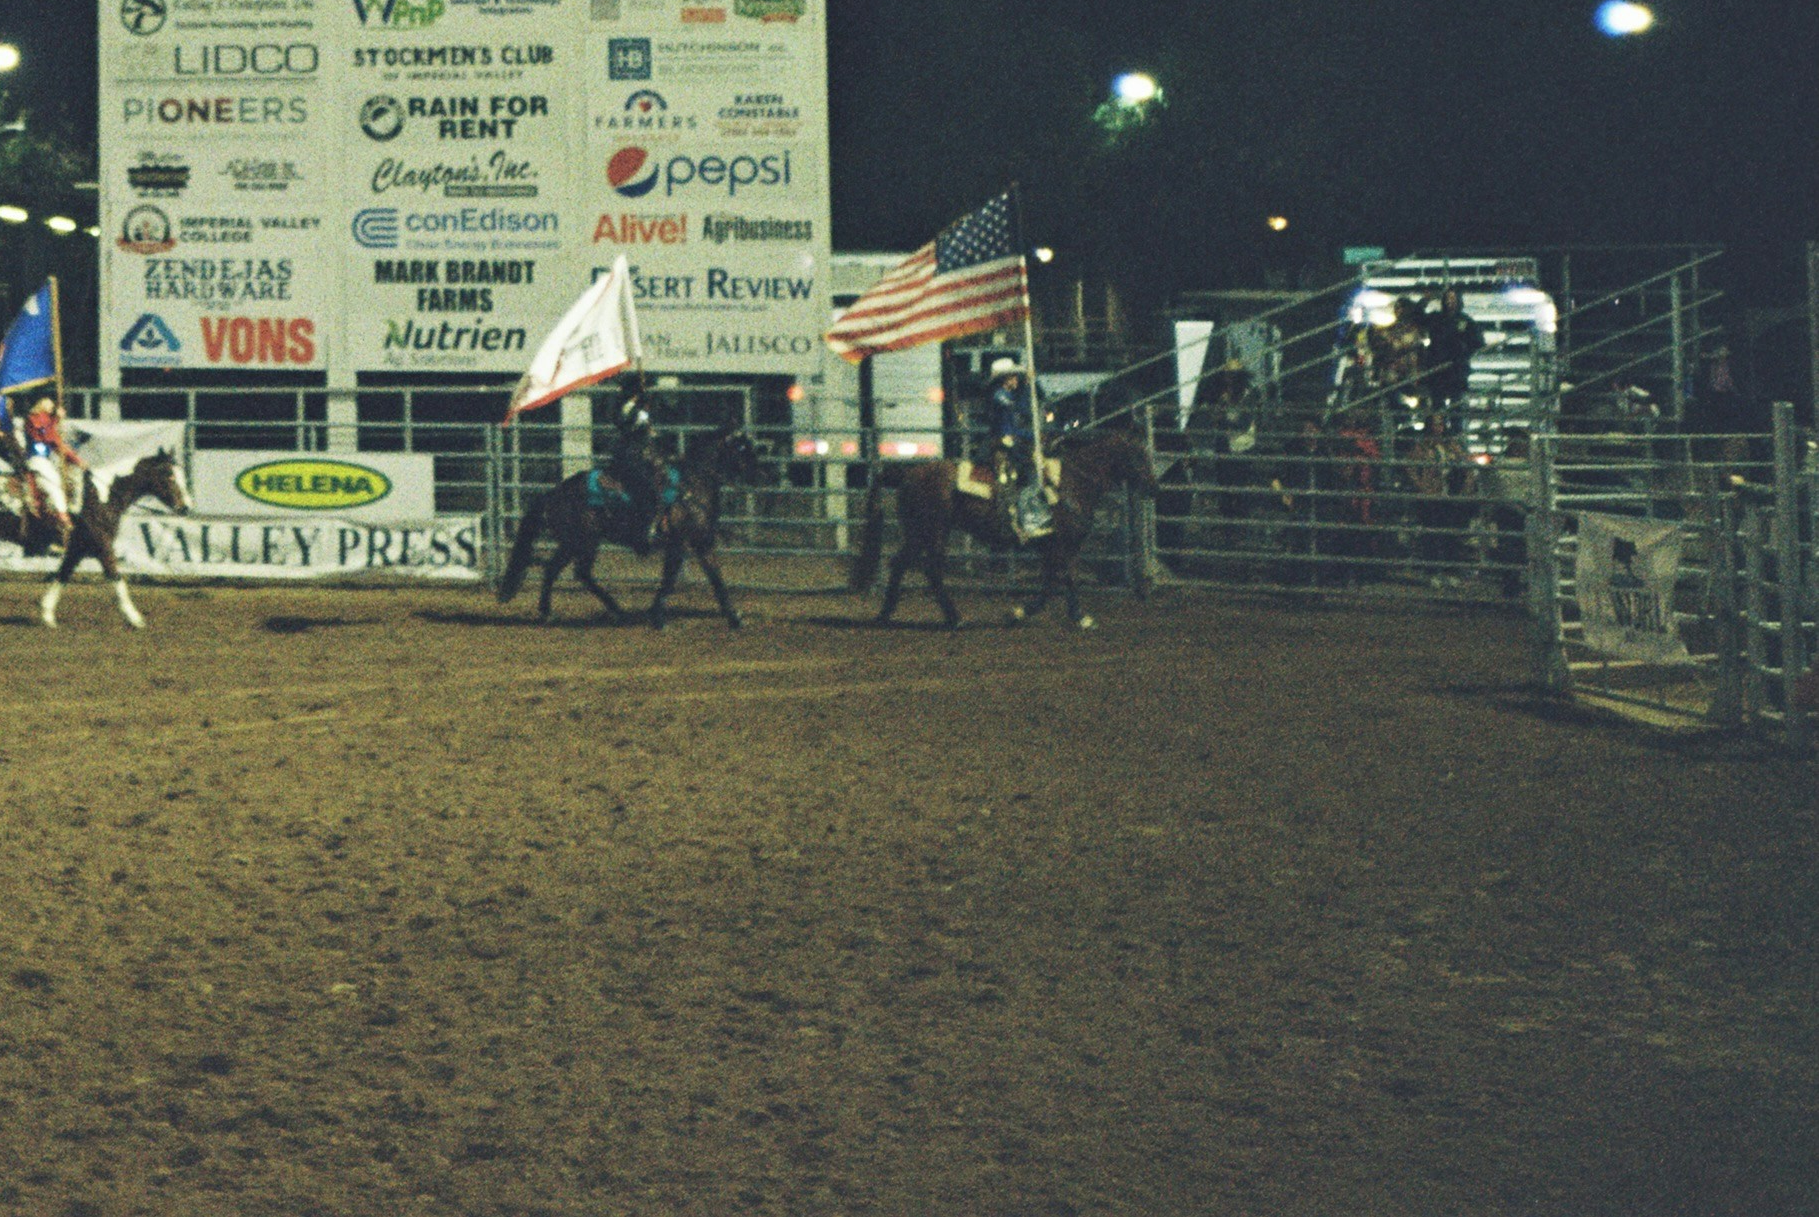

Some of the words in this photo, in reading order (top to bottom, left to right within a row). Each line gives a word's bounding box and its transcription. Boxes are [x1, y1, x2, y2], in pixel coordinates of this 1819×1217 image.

[174, 42, 319, 75] LIDCO
[354, 46, 494, 68] STOCKMEN'S
[500, 44, 554, 66] CLUB
[123, 96, 308, 125] PIONEERS
[408, 96, 479, 117] RAIN
[489, 94, 549, 117] FOR
[438, 118, 517, 140] RENT
[595, 115, 698, 130] FARMERS
[667, 149, 792, 197] pepsi
[261, 216, 321, 229] VALLEY
[405, 208, 560, 233] conEdison
[593, 214, 688, 244] Alive!
[180, 232, 251, 243] COLLEGE
[144, 258, 293, 281] ZENDEJAS
[374, 259, 439, 284] MARK
[445, 258, 536, 284] BRANDT
[707, 267, 814, 299] REVIEW
[417, 288, 494, 312] FARMS
[199, 316, 316, 364] VONS
[384, 318, 527, 351] Nutrien
[705, 333, 812, 356] JALISCO
[252, 474, 376, 494] HELENA
[139, 522, 321, 568] VALLEY
[338, 524, 478, 569] PRESS
